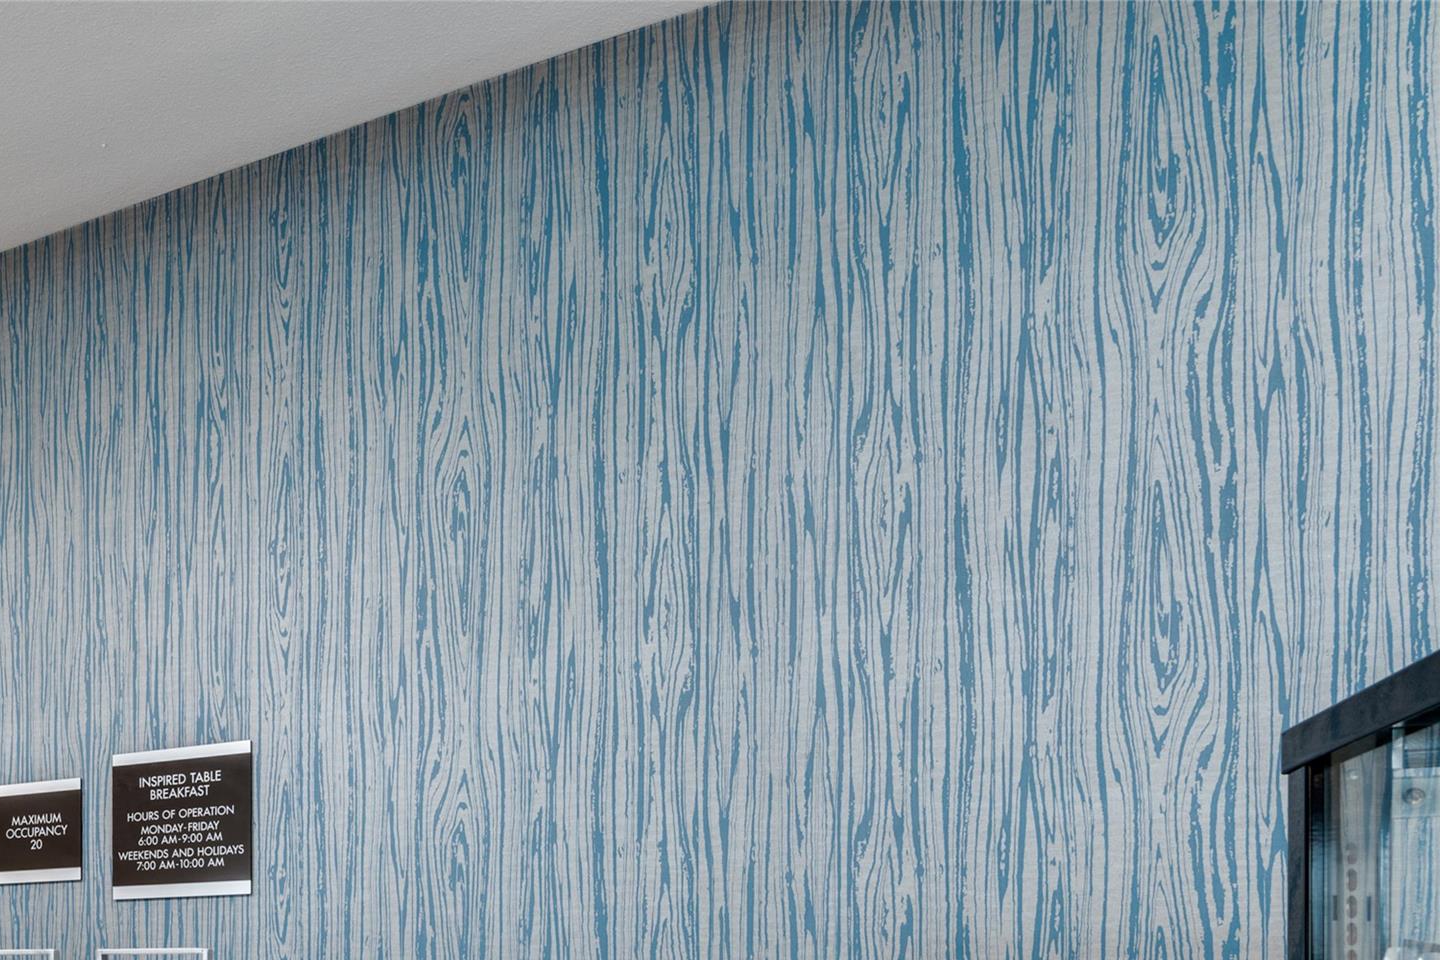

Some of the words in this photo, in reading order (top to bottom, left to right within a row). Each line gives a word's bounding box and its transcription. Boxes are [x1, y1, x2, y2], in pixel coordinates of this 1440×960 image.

[139, 773, 186, 788] INSPIRED
[190, 770, 222, 783] TABLE
[150, 785, 210, 801] BREAKFAST
[11, 813, 62, 826] MAXIMUM
[127, 810, 159, 822] HOURS
[162, 809, 176, 820] OF
[179, 805, 235, 818] OPERATION
[5, 824, 68, 839] OCCUPANCY
[141, 820, 219, 835] MONDAY-FRIDAY
[30, 839, 43, 850] 20
[138, 834, 158, 846] 6:00
[207, 831, 223, 842] AM
[119, 848, 169, 861] WEEKENDS
[172, 846, 195, 858] AND
[197, 844, 245, 857] HOLIDAYS
[136, 860, 155, 871] 7:00
[208, 857, 225, 867] AM
